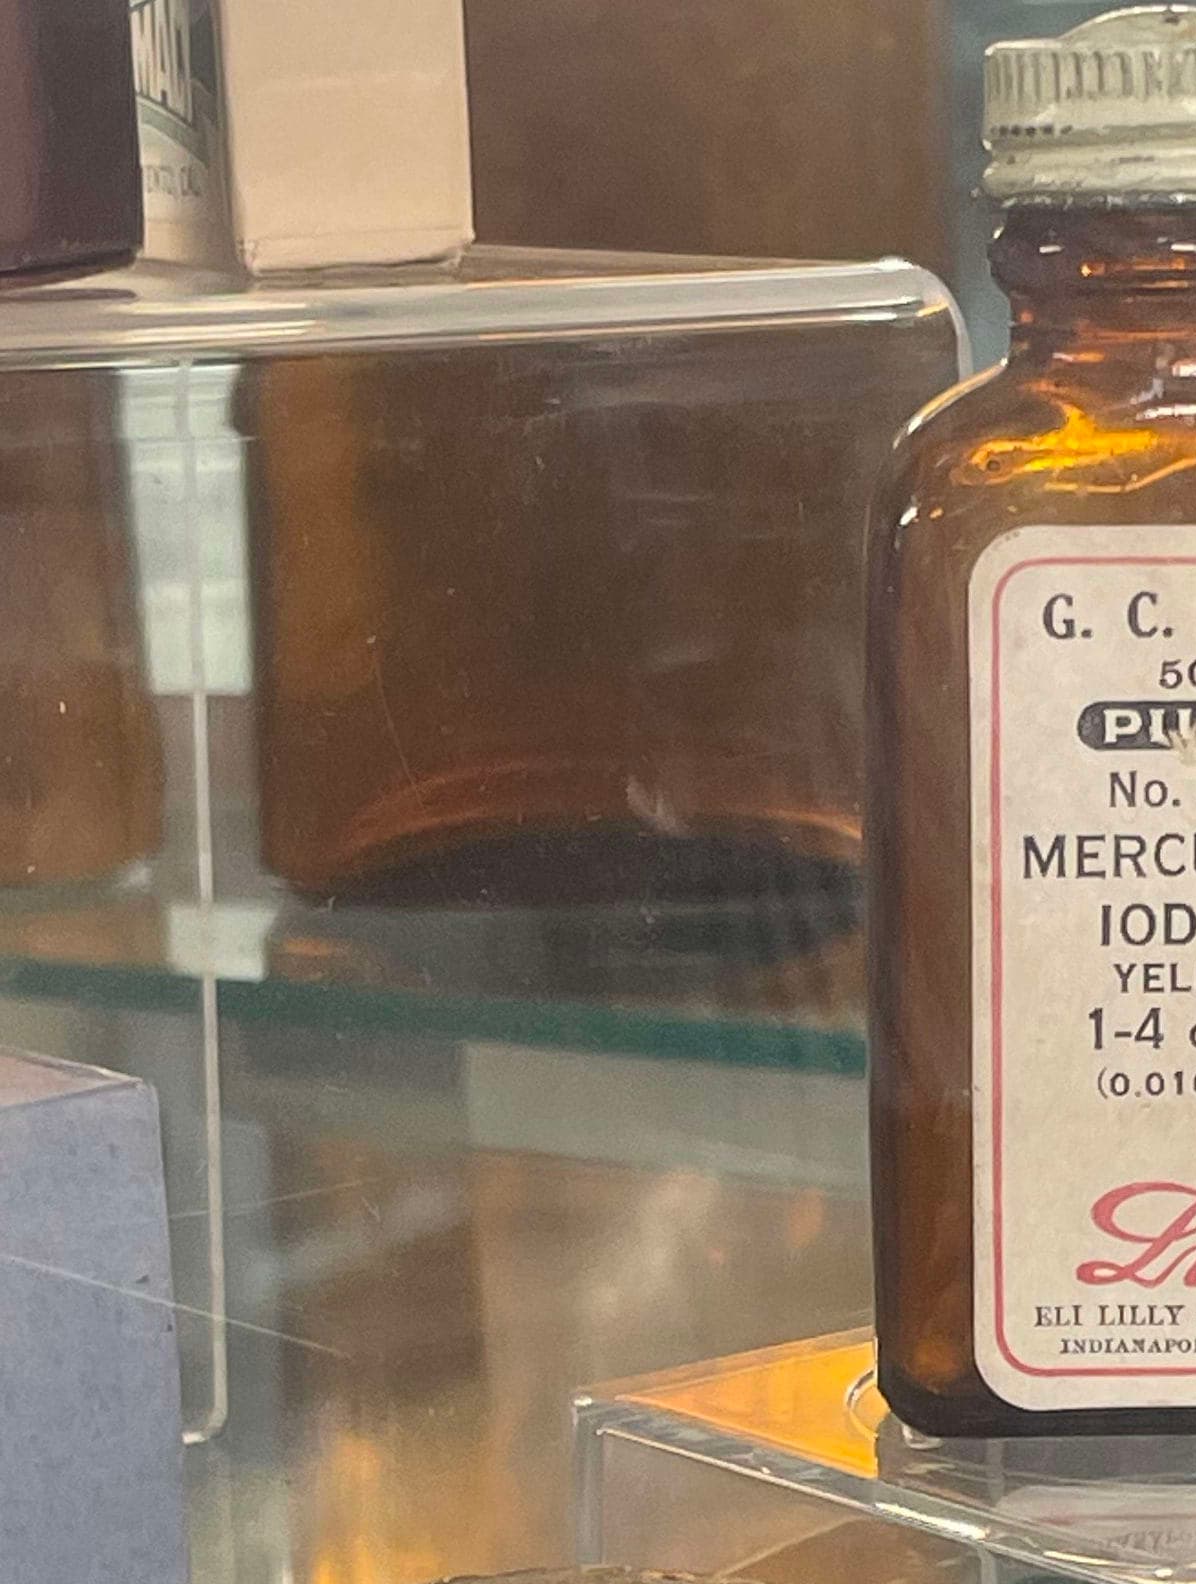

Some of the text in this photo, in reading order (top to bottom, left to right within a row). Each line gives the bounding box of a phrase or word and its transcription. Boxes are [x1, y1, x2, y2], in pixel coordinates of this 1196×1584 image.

[1042, 592, 1092, 640] G.
[1127, 590, 1174, 638] C.
[1108, 769, 1181, 808] No.
[1087, 1006, 1165, 1051] 1-4
[1033, 1304, 1084, 1328] ELI
[1098, 1303, 1186, 1327] LILLY
